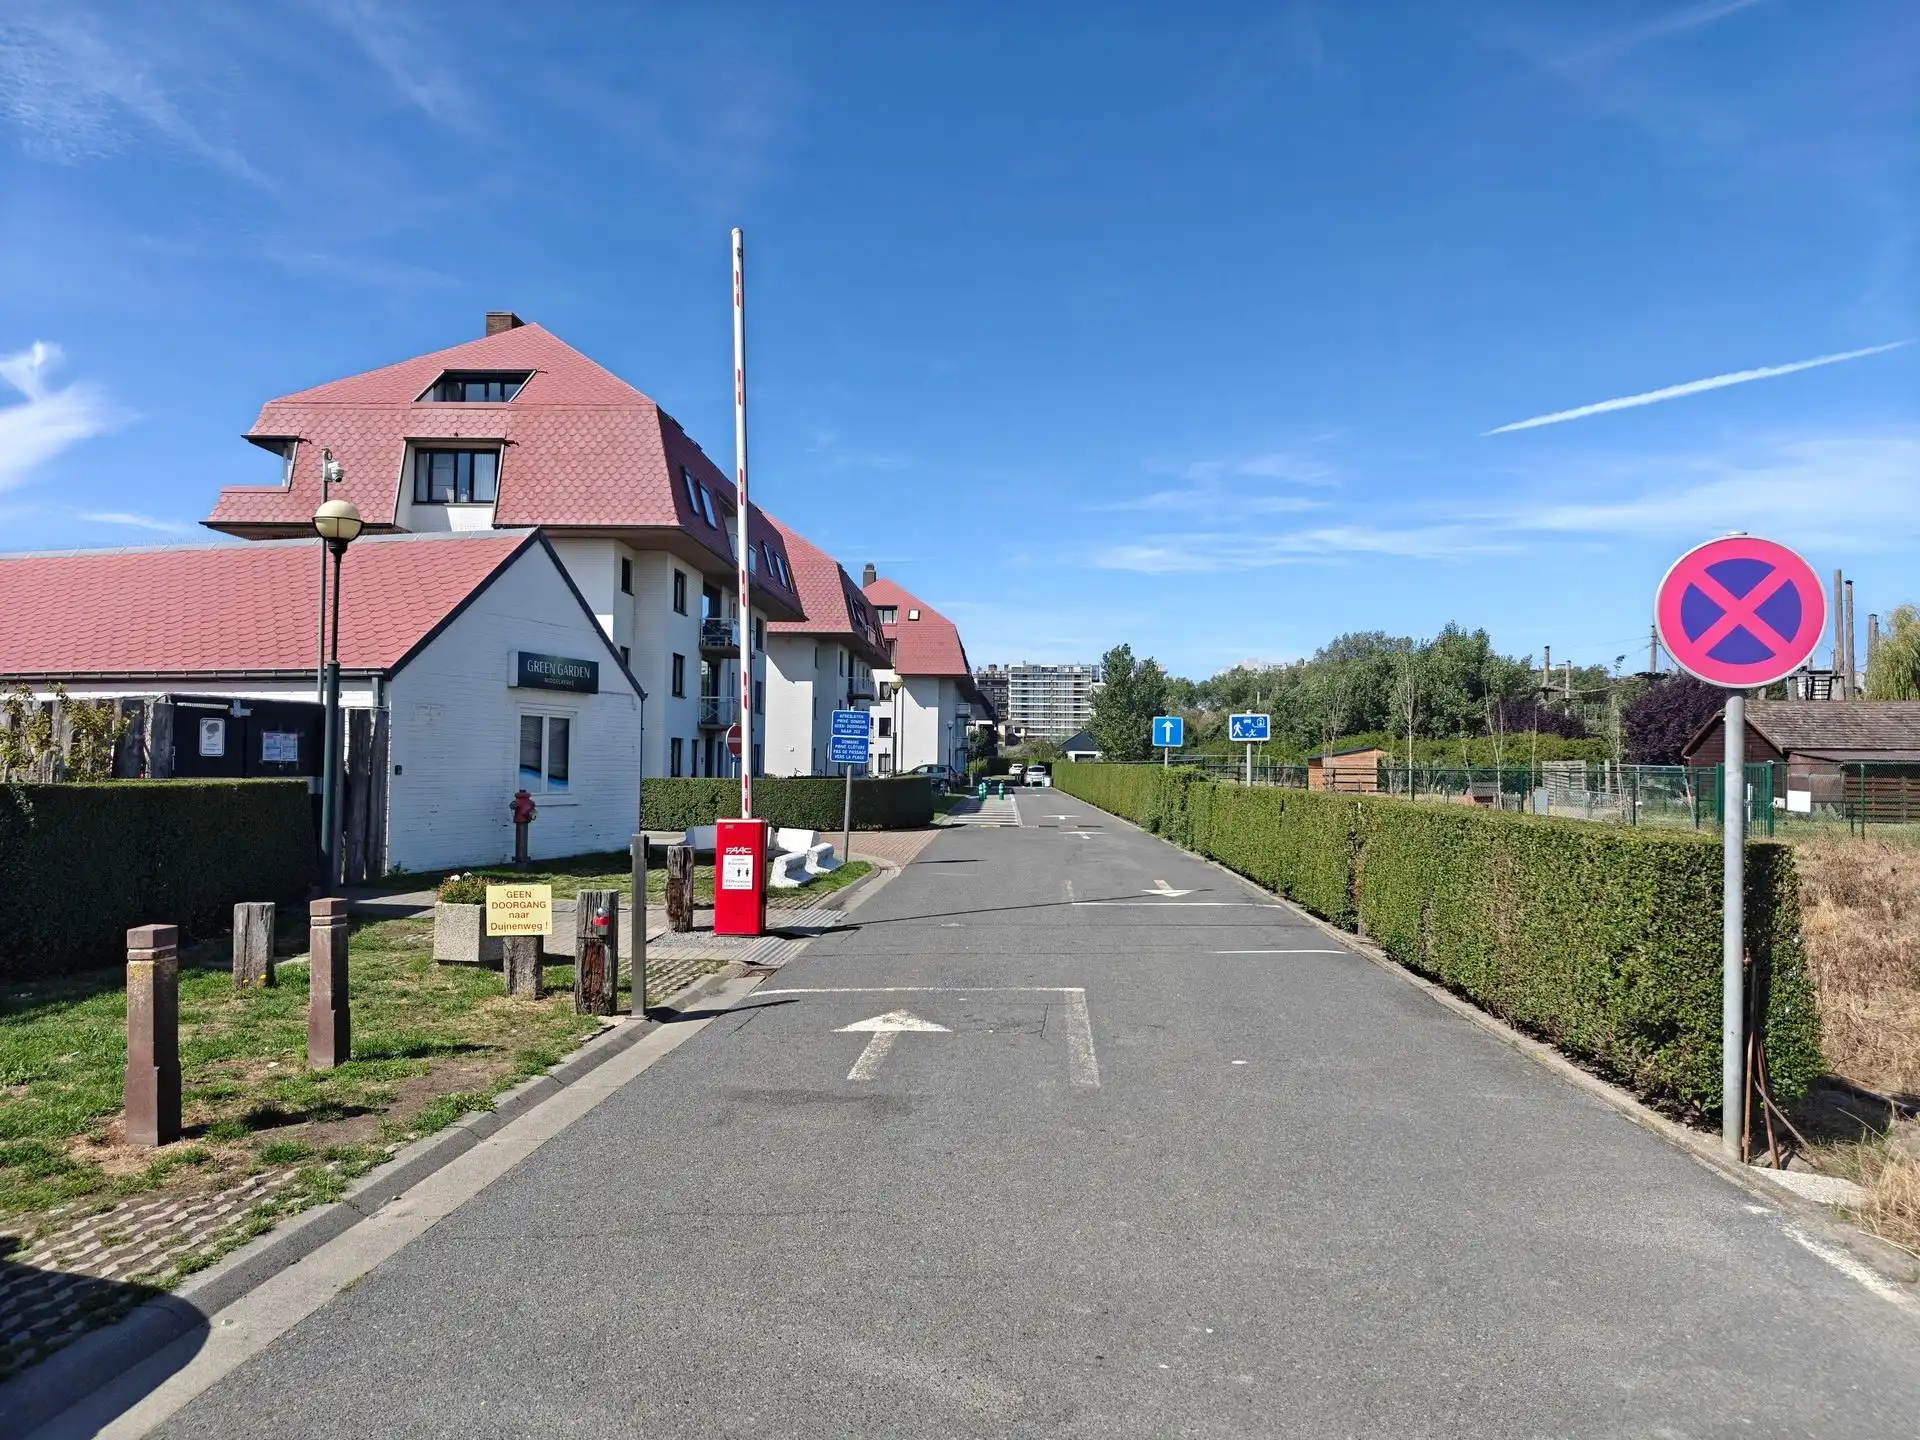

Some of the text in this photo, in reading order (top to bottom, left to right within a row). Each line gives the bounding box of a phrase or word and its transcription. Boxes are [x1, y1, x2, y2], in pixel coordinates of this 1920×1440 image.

[527, 660, 590, 678] GREEN GARDEN
[491, 901, 546, 909] DOORGANG
